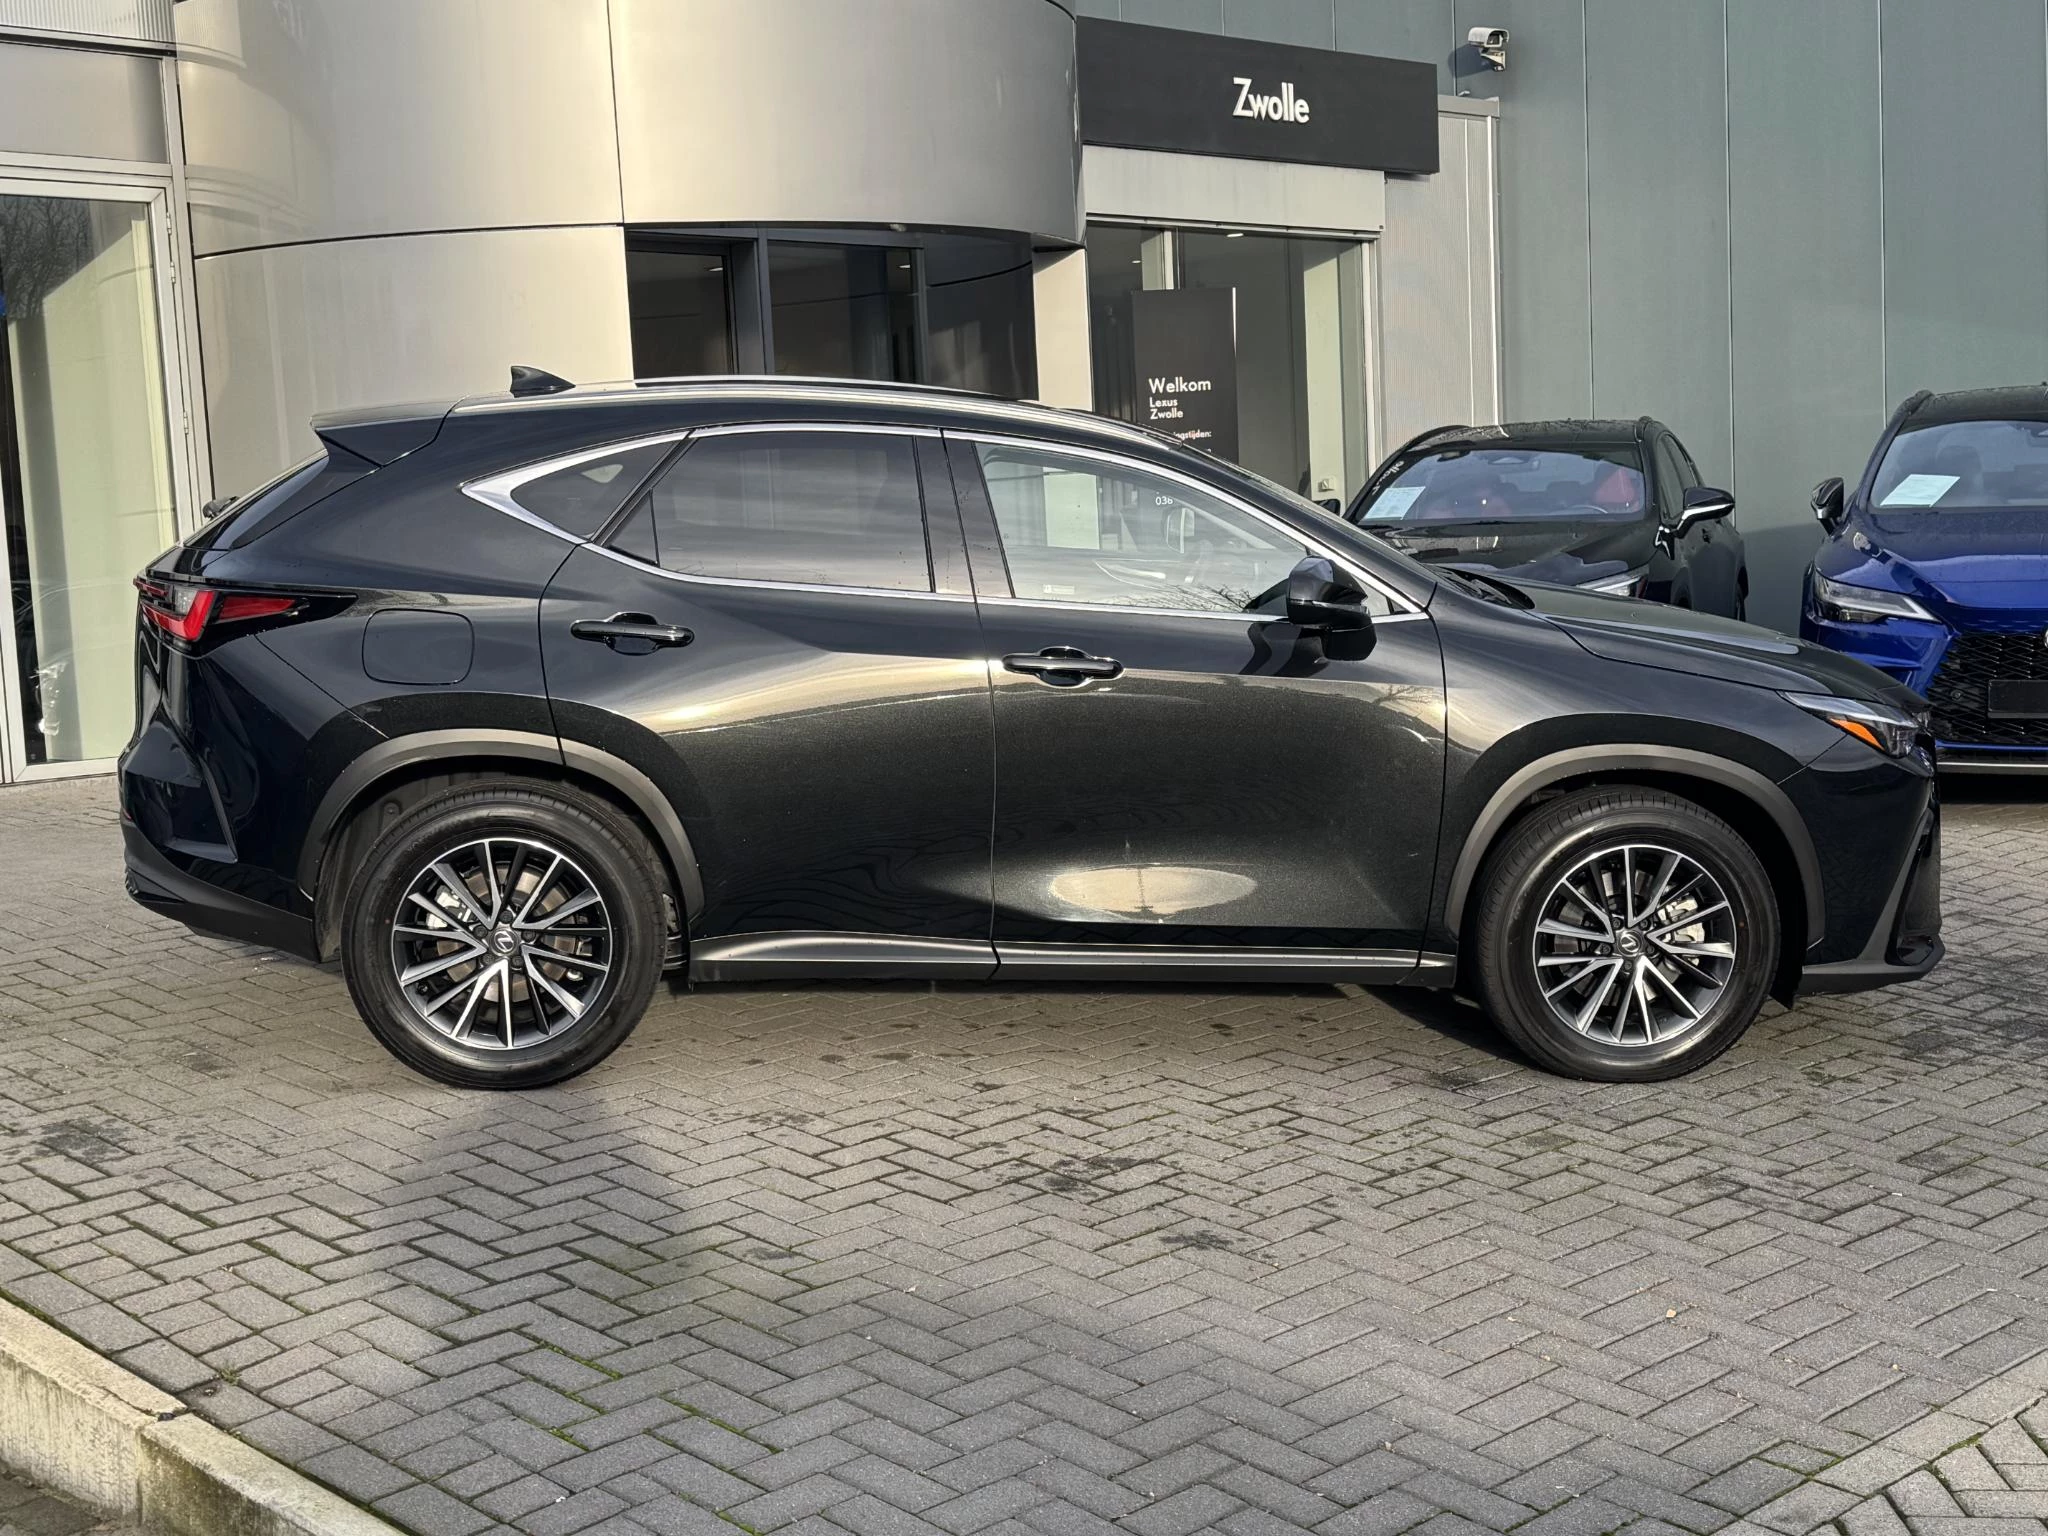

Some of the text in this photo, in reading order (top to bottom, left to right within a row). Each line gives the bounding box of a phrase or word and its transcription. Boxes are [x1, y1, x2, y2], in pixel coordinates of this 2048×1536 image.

[1233, 77, 1310, 123] Zwolle
[1148, 376, 1211, 394] Welkom
[1149, 397, 1178, 407] Lexus
[1150, 408, 1184, 420] Zwolle
